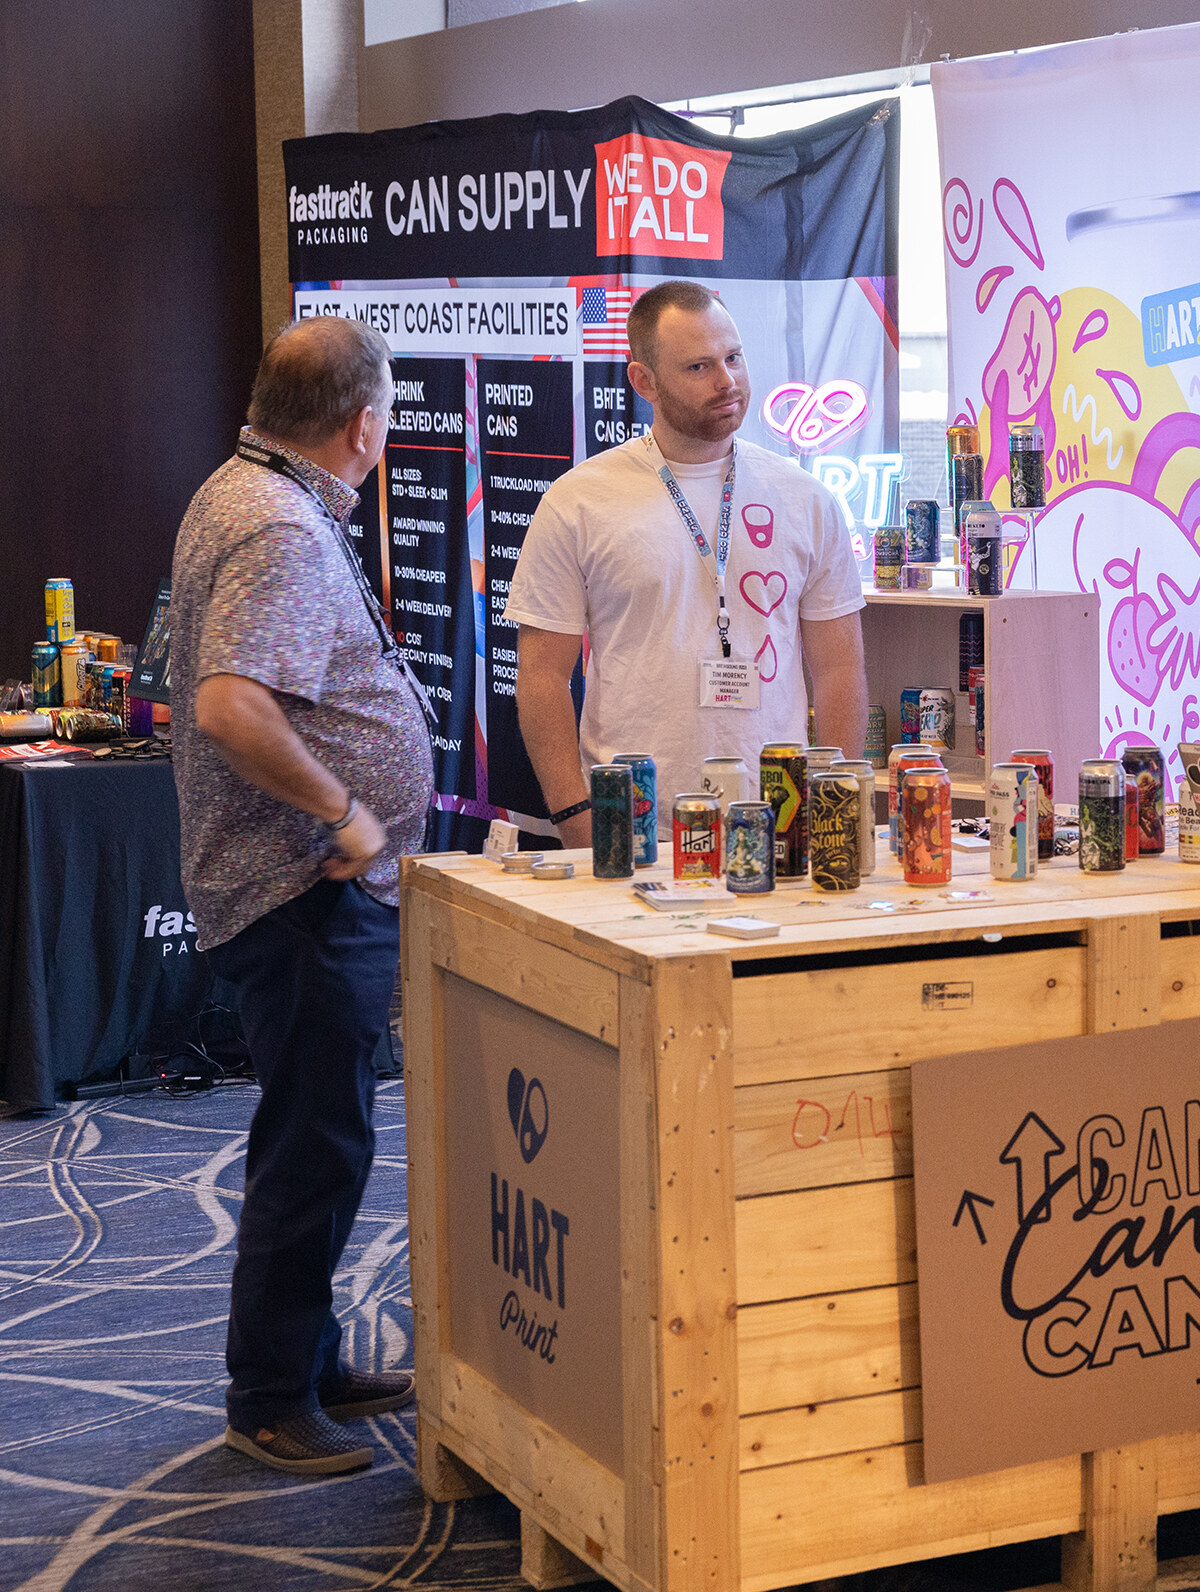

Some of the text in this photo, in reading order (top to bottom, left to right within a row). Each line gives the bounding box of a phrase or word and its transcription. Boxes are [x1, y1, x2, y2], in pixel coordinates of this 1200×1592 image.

[604, 153, 708, 200] WE DO
[289, 180, 373, 223] fasttrack
[385, 167, 592, 237] CAN SUPPLY
[608, 196, 709, 243] IT ALL
[298, 226, 369, 246] PACKAGING
[354, 302, 400, 335] WEST
[404, 301, 462, 335] COAST
[468, 302, 569, 336] FACILITIES
[393, 380, 425, 402] HRINK
[485, 383, 533, 407] PRINTED
[388, 410, 463, 434] SLEEVED CANS
[487, 414, 518, 437] CANS
[1056, 433, 1088, 484] OH!
[392, 467, 403, 480] ALL
[494, 475, 533, 492] TRUCKLOAD
[392, 485, 448, 501] STD SLEEK SLIM
[393, 516, 445, 534] AWARD WINNING
[491, 510, 511, 525] 10-40%
[393, 533, 420, 547] QUALITY
[491, 545, 501, 558] 2-4
[394, 565, 447, 585] 10-30% CHEAPER
[396, 598, 405, 611] 2-4
[406, 601, 423, 614] WEEK
[491, 595, 508, 610] EAST
[406, 633, 422, 646] COST
[400, 648, 428, 665] PECIALTY
[493, 647, 516, 663] EASIER
[682, 826, 715, 854] Hart
[490, 1172, 570, 1310] HART
[500, 1290, 558, 1364] Print
